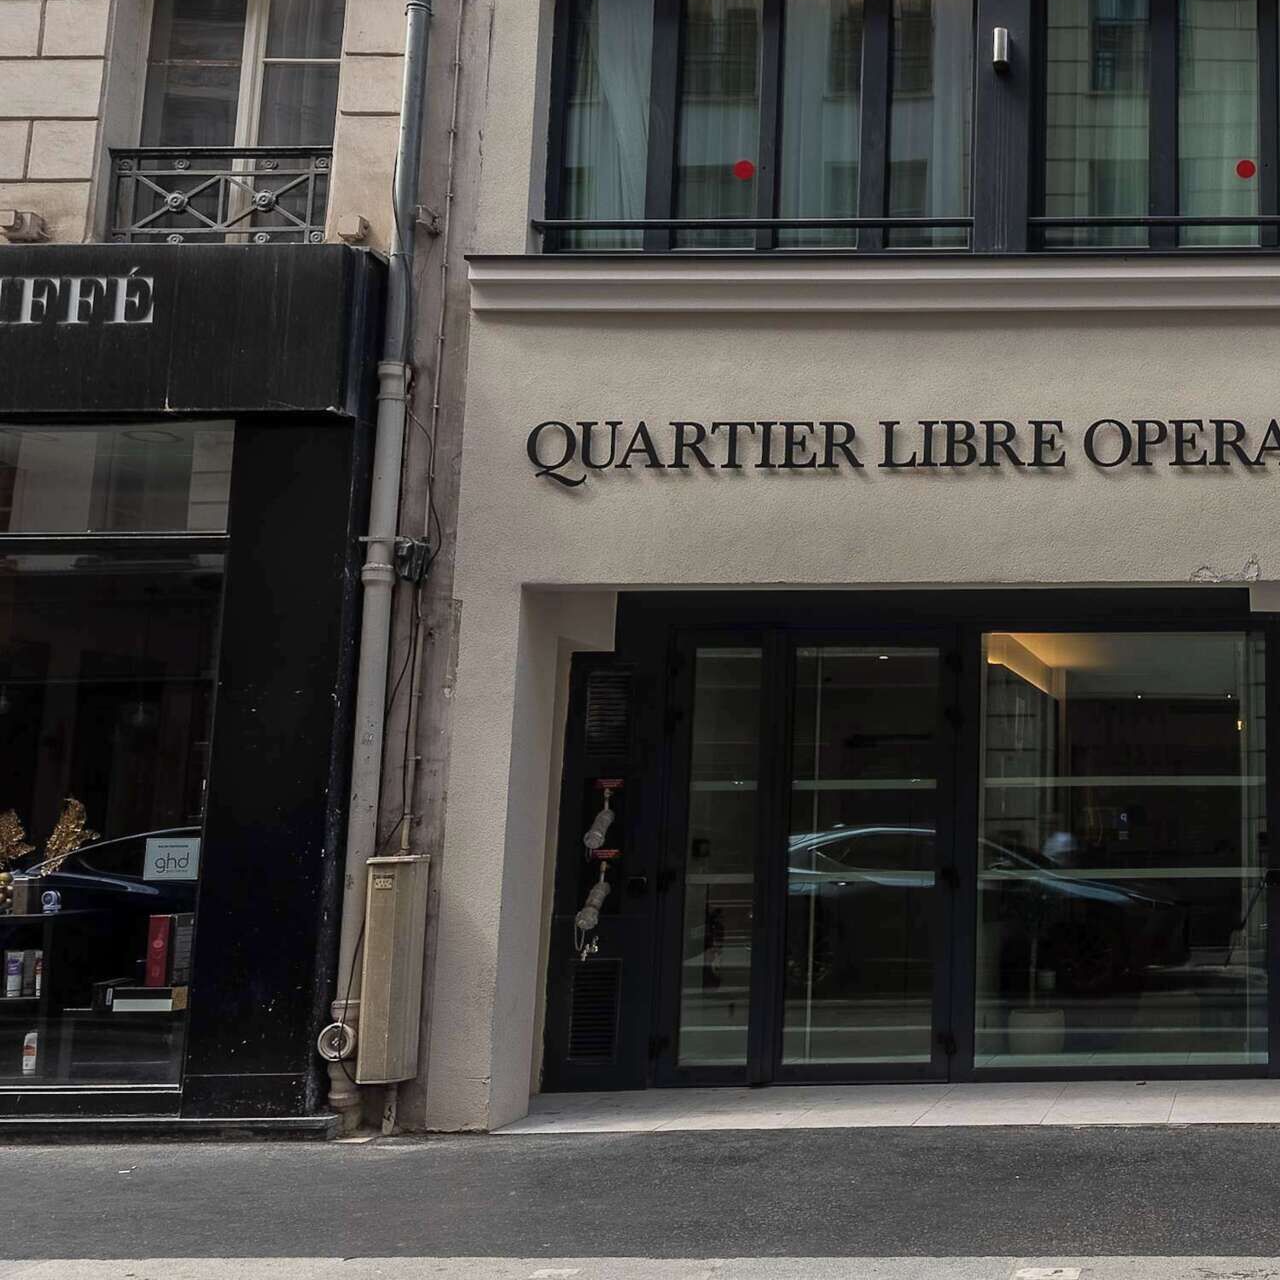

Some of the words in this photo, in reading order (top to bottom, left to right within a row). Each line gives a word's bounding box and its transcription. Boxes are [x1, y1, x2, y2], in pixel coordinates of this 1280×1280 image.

[0, 266, 154, 324] FFÉ
[526, 420, 864, 487] QUARTIER
[878, 420, 1066, 467] LIBRE
[154, 851, 190, 874] ghd
